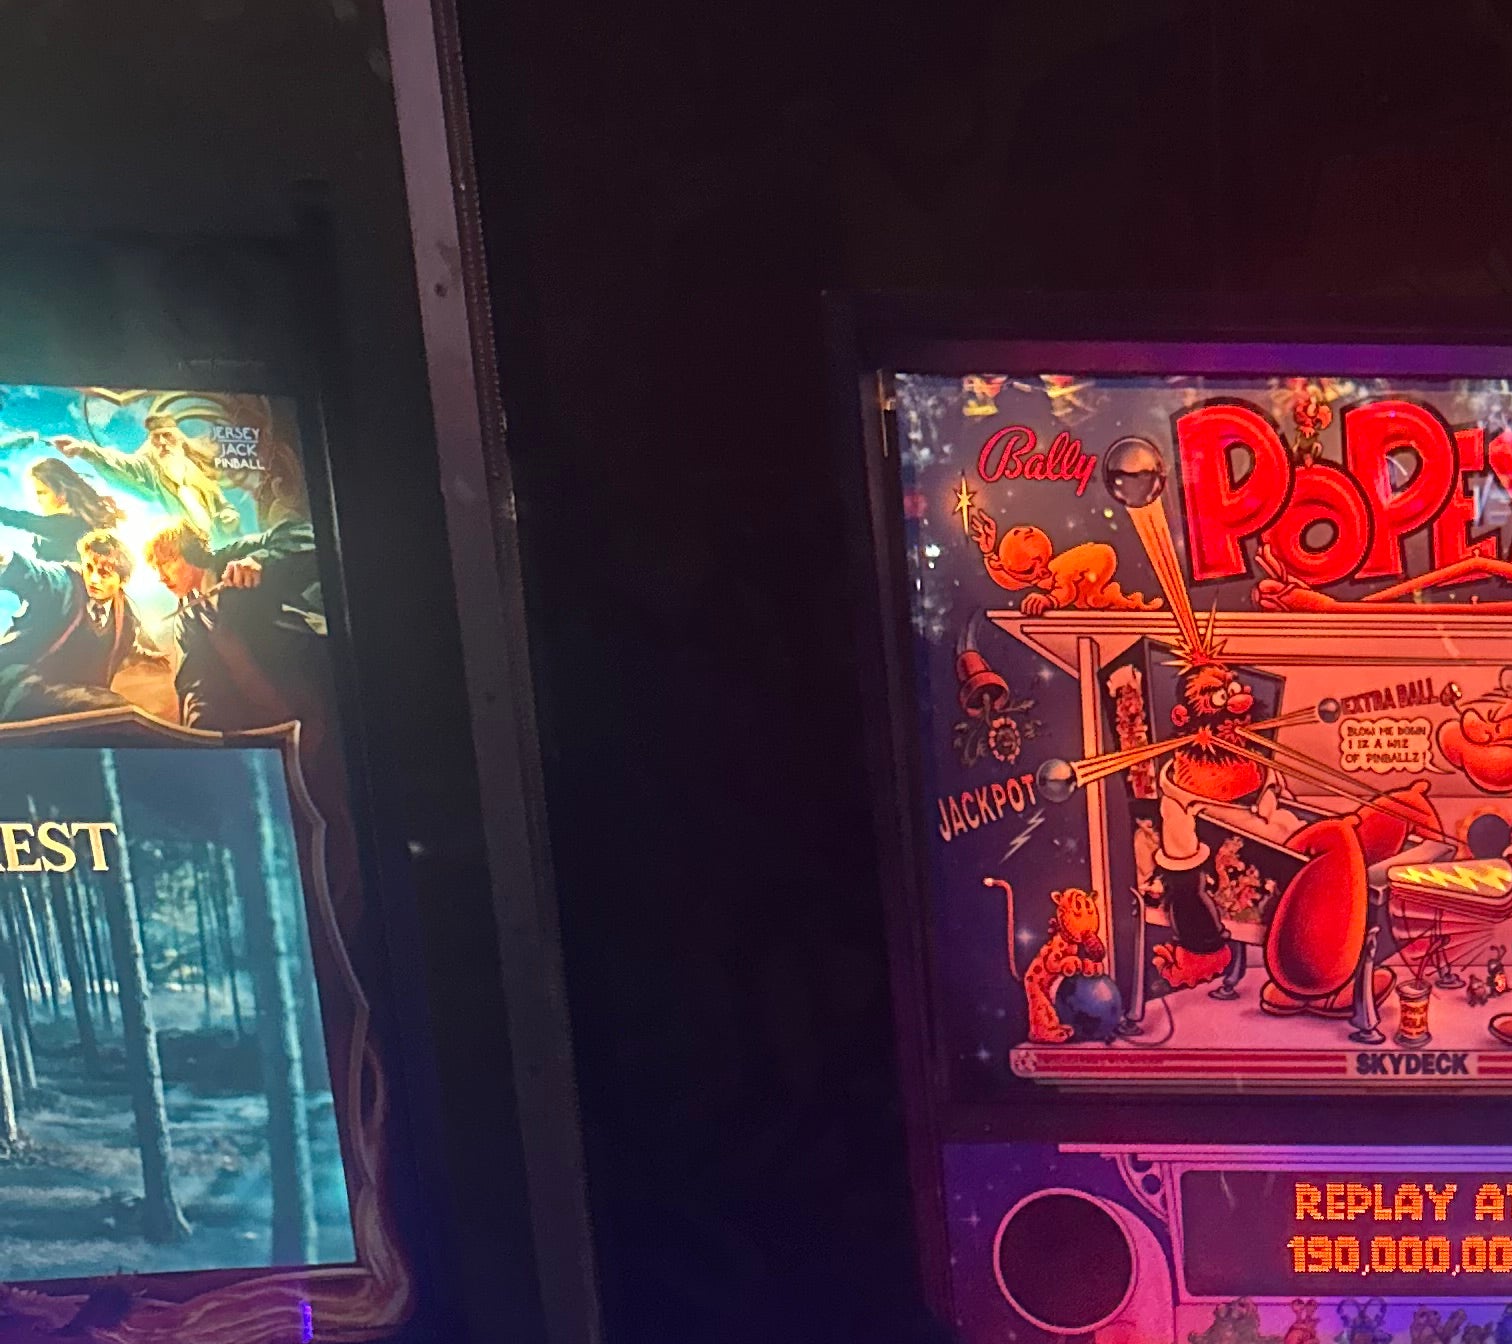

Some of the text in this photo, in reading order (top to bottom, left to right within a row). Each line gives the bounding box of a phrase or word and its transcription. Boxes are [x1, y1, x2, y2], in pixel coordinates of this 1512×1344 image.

[210, 426, 260, 442] JERSEY
[218, 442, 258, 458] JACK
[214, 457, 265, 471] PINBALL
[978, 425, 1096, 496] Bally
[1340, 677, 1439, 715] EXTRA BALL
[937, 772, 1037, 843] JACKPOT
[0, 821, 118, 873] EST
[1356, 1053, 1470, 1076] SKYDECK
[1295, 1182, 1458, 1221] REPLAY
